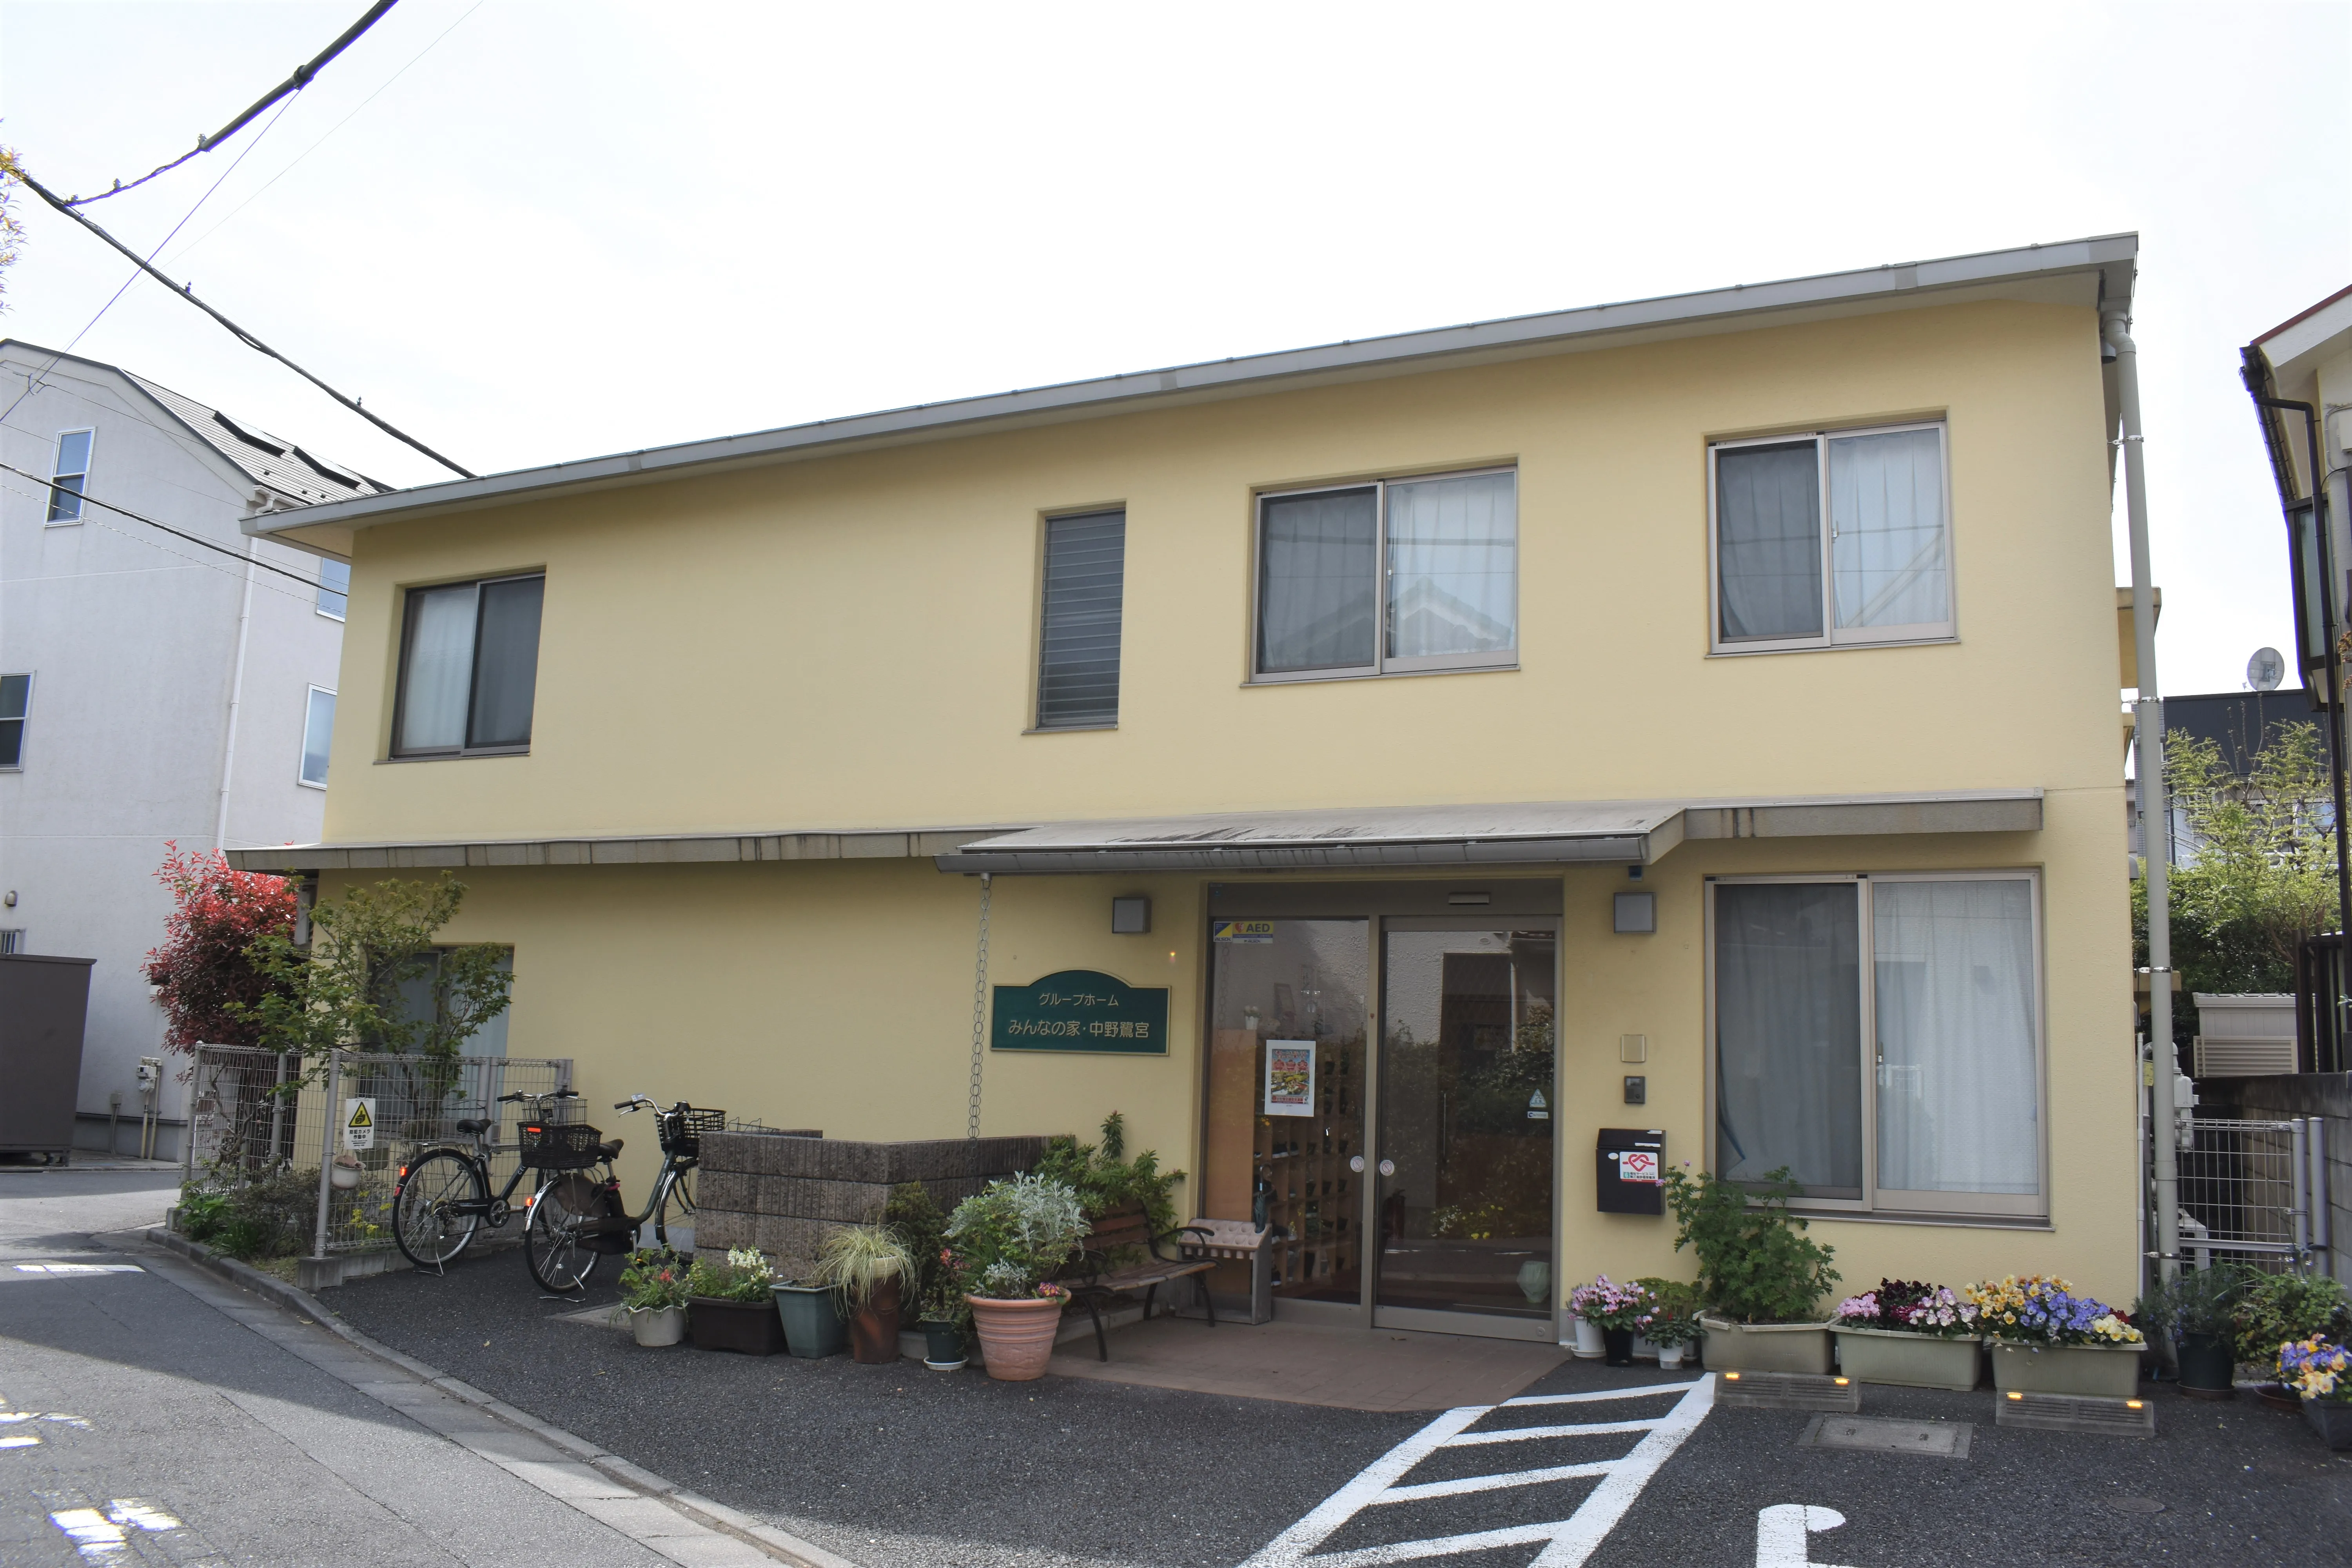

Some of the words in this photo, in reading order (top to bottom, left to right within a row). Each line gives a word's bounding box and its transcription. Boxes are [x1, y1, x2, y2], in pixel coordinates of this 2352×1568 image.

[1246, 924, 1270, 932] AED
[1039, 993, 1119, 1007] グループホーム
[1008, 1019, 1149, 1038] みんなの家・中野鷺宮
